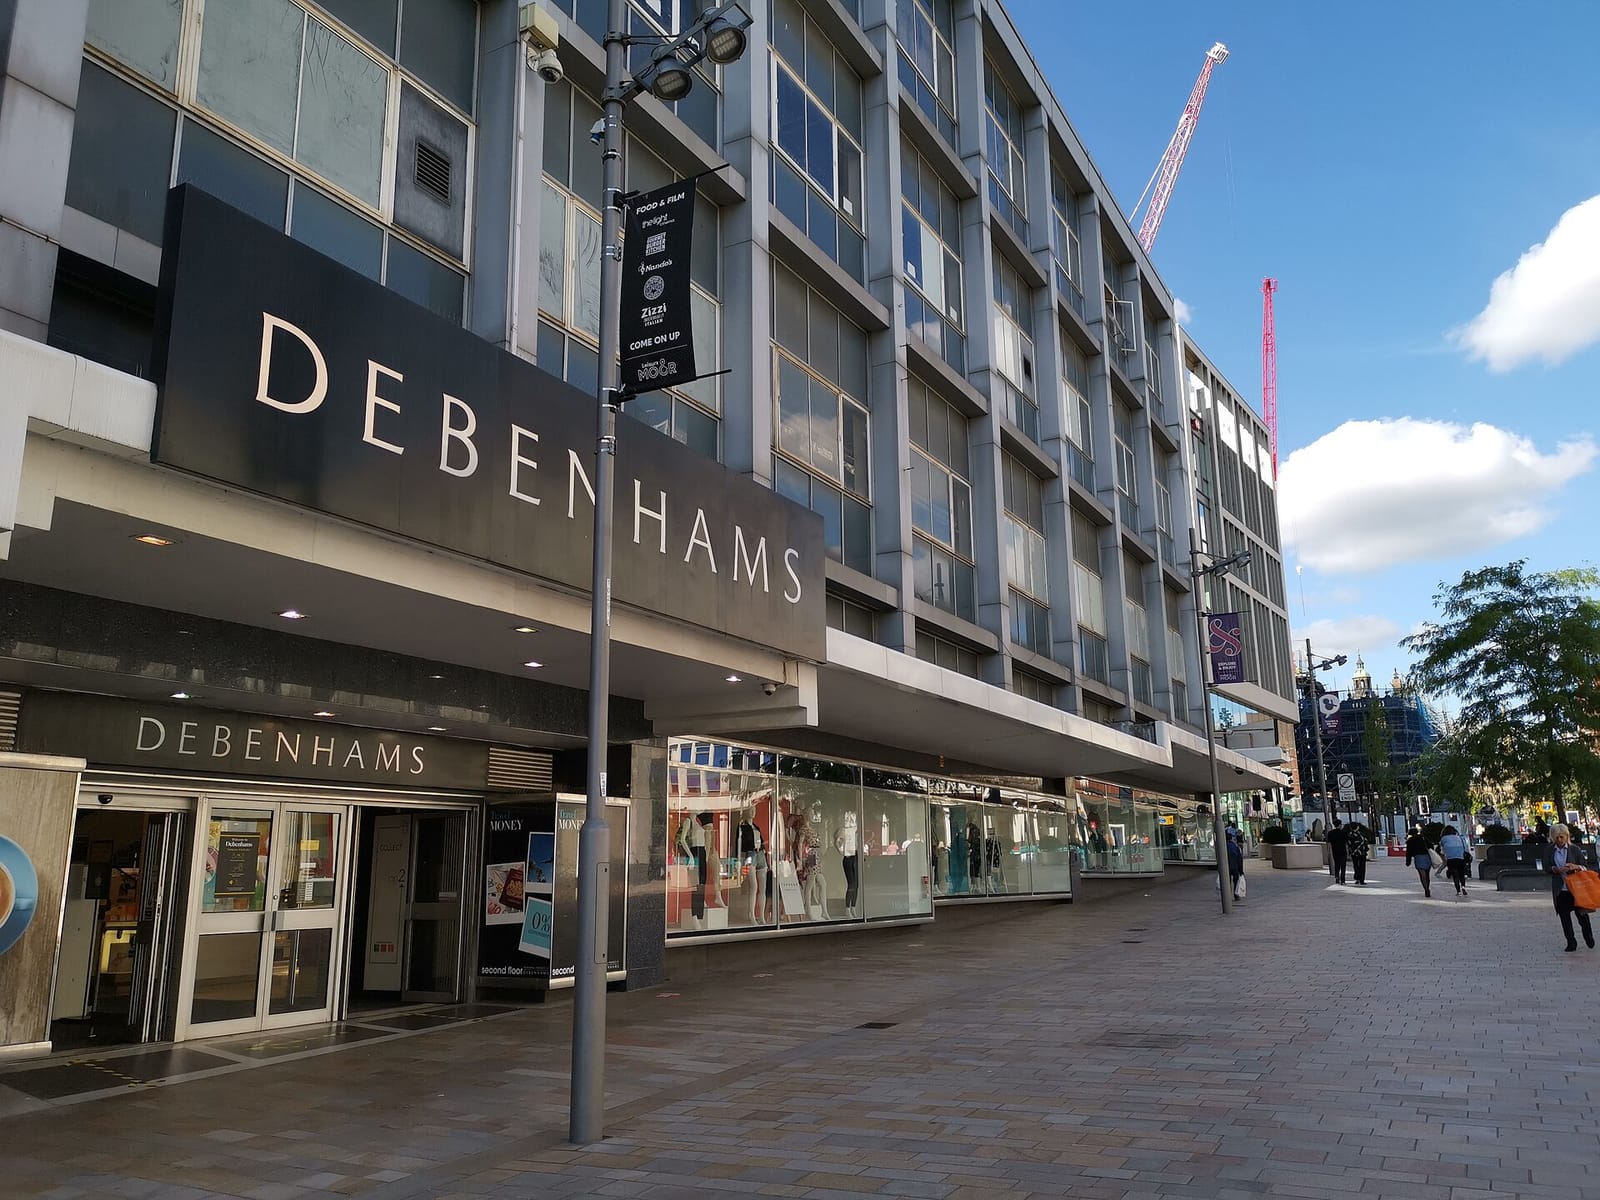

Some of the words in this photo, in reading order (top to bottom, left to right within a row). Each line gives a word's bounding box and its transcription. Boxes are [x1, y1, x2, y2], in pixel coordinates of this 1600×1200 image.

[636, 201, 658, 215] FOOD
[659, 199, 666, 207] &
[666, 192, 685, 205] FILM
[645, 258, 673, 273] Nando's
[641, 302, 667, 319] Zizzi
[629, 337, 653, 351] COME
[654, 334, 668, 345] ON
[668, 331, 681, 342] UP
[254, 311, 803, 606] DEBENHAMS
[135, 716, 427, 776] DEBENHAMS
[490, 819, 524, 832] MONEY
[558, 818, 585, 830] MONE
[481, 965, 507, 975] second
[507, 965, 524, 975] floor
[552, 965, 575, 976] second
